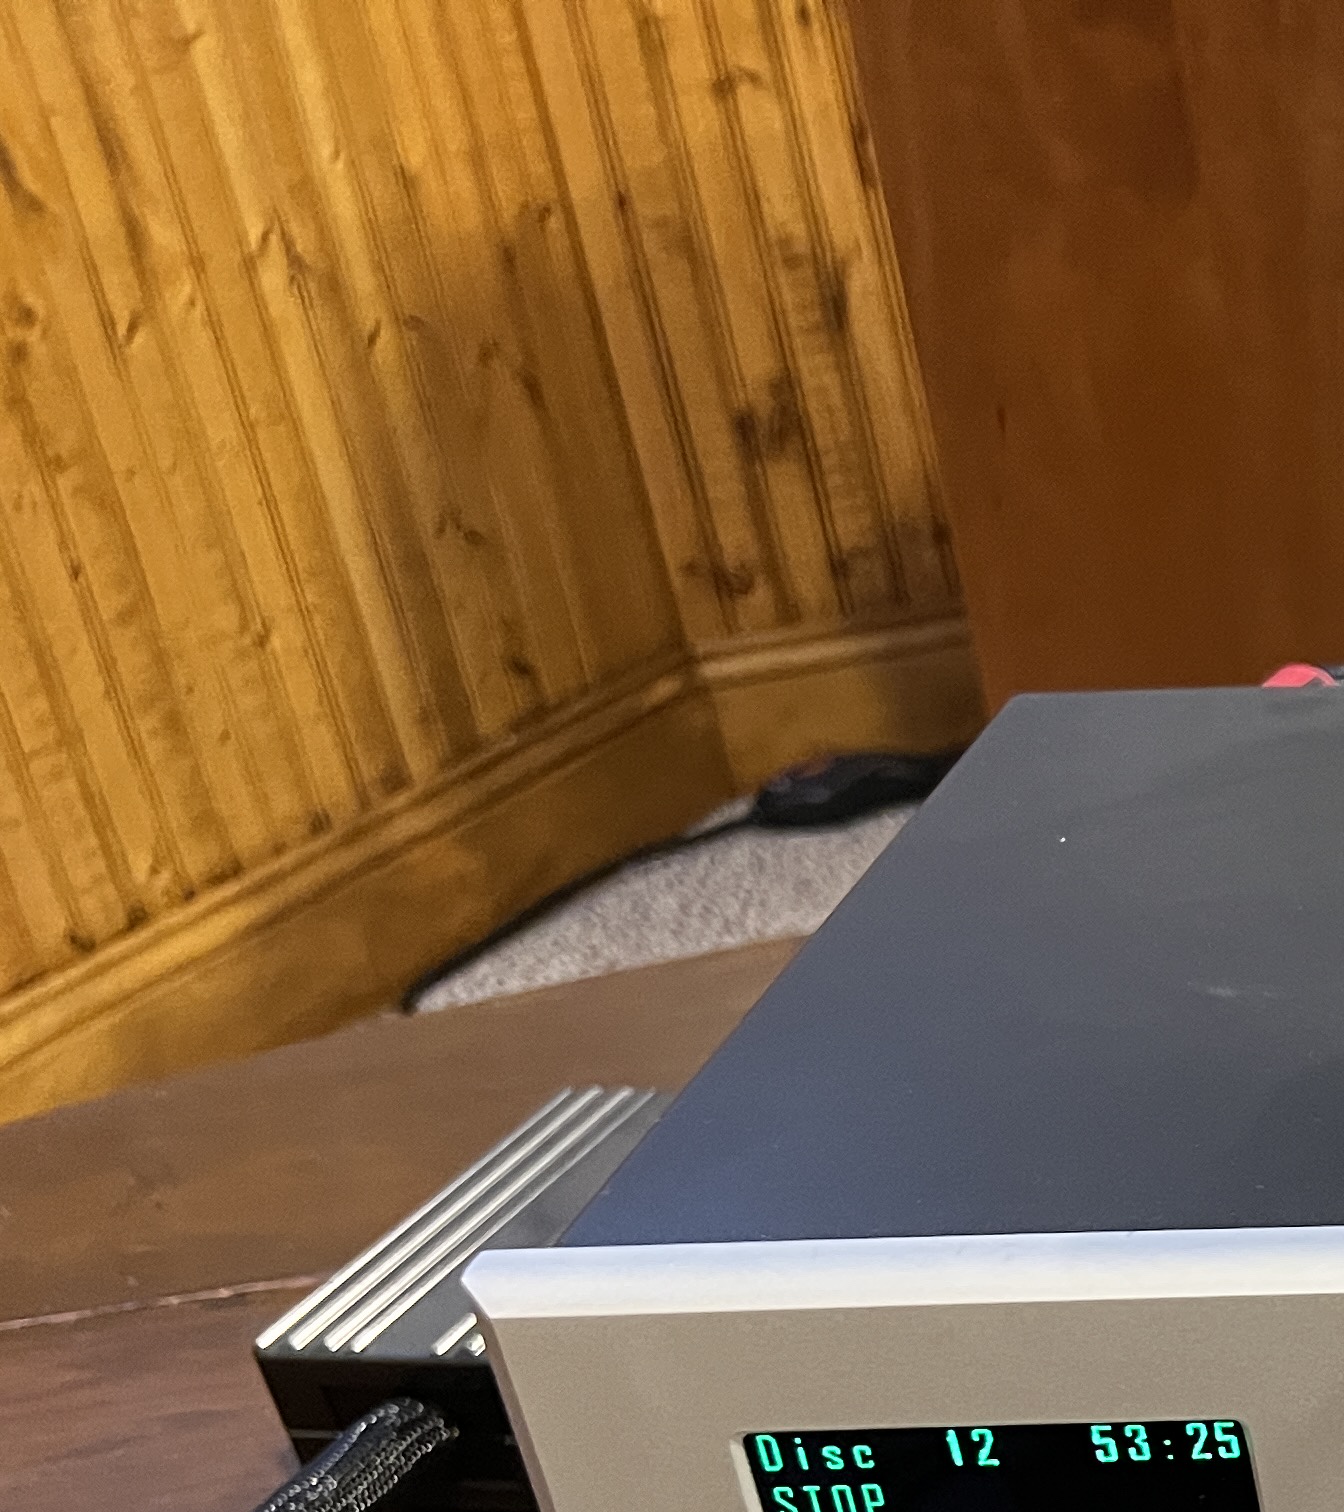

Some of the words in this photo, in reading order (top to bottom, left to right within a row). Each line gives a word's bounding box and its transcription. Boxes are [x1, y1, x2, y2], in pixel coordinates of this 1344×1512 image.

[755, 1433, 876, 1472] Disc
[944, 1428, 1000, 1467] 12
[1089, 1421, 1242, 1463] 53:25
